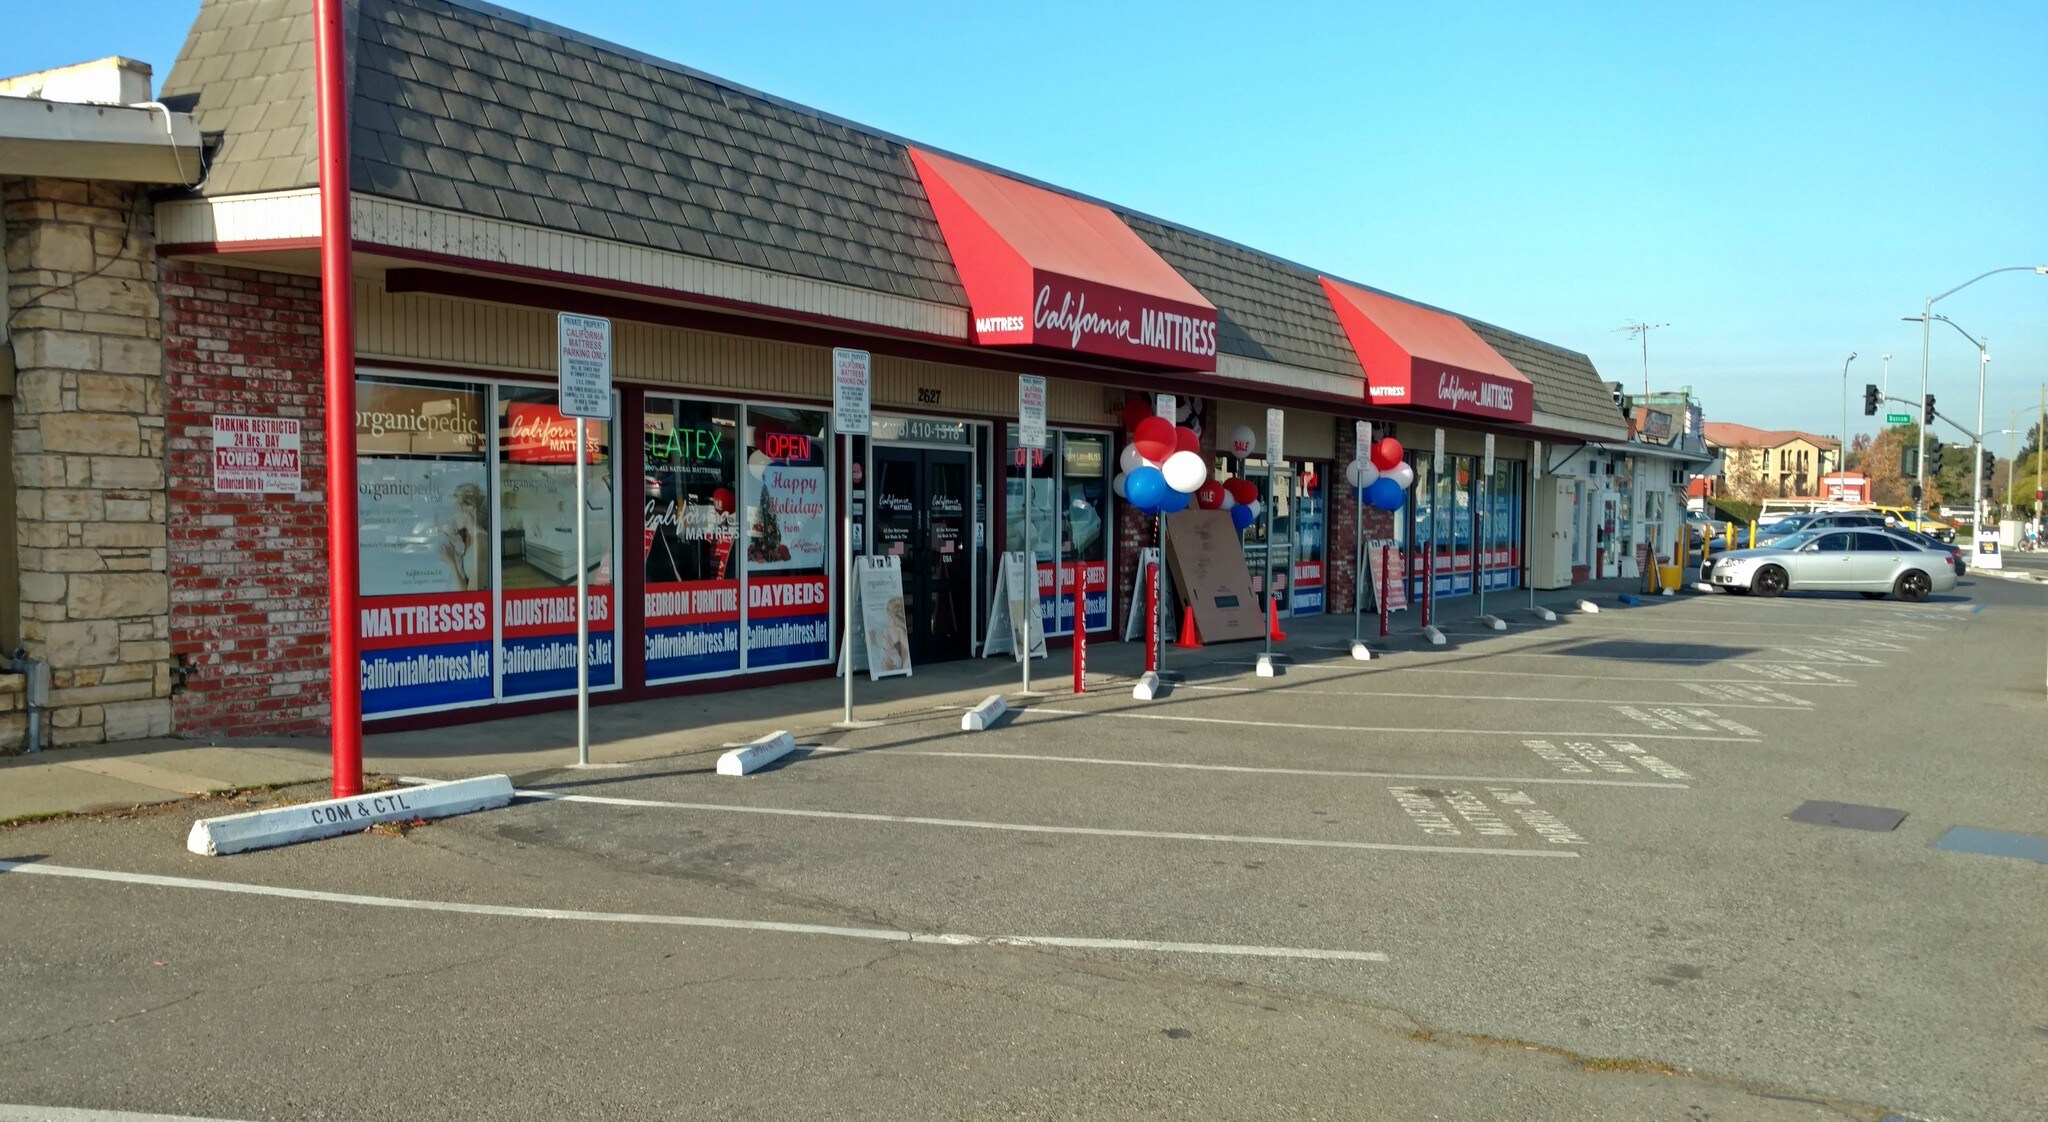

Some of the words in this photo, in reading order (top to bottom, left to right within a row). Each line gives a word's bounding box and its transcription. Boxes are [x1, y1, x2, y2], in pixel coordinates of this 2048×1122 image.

[976, 316, 1024, 333] MATTRESS
[1034, 284, 1141, 349] California
[1140, 307, 1217, 357] MATTRESS
[566, 328, 604, 341] CALIFORNIA
[569, 339, 603, 350] MATTRESS
[562, 347, 590, 359] PARKING
[591, 350, 607, 360] ONLY
[918, 388, 941, 404] 2627
[1369, 385, 1405, 397] MATTRESS
[1438, 371, 1482, 410] California
[1480, 382, 1513, 411] MATTRESS
[215, 417, 249, 433] PARKING
[252, 419, 297, 435] RESTRICTED
[511, 415, 600, 447] Californa
[234, 433, 244, 447] 24
[266, 435, 279, 447] DAY
[550, 441, 600, 453] MATTESS
[652, 427, 723, 460] LATEX
[768, 435, 810, 459] OPEN
[1234, 440, 1249, 453] SALE
[218, 451, 260, 468] TOWED
[264, 452, 296, 468] AWAY
[670, 465, 691, 473] NATURAL
[771, 472, 817, 494] Happy
[645, 498, 739, 536] California
[768, 497, 824, 520] Holidays
[686, 526, 740, 541] MATTRESS
[784, 521, 800, 533] from
[645, 591, 690, 618] BEDROOM
[691, 587, 738, 614] FURNITURE
[749, 582, 825, 608] DAYBEDS
[361, 602, 486, 639] MATTRESSES
[504, 596, 576, 627] ADJUSTABLE
[587, 595, 608, 620] EDS
[644, 627, 738, 661] CaliforniaMattress.Net
[746, 620, 828, 651] CaliforniaMattress.Net
[501, 638, 612, 675] CaliforniaMattrs.Net
[360, 650, 490, 692] CaliforniaMattress.Net
[311, 806, 352, 825] COM
[357, 802, 371, 817] &
[374, 794, 412, 814] CTL
